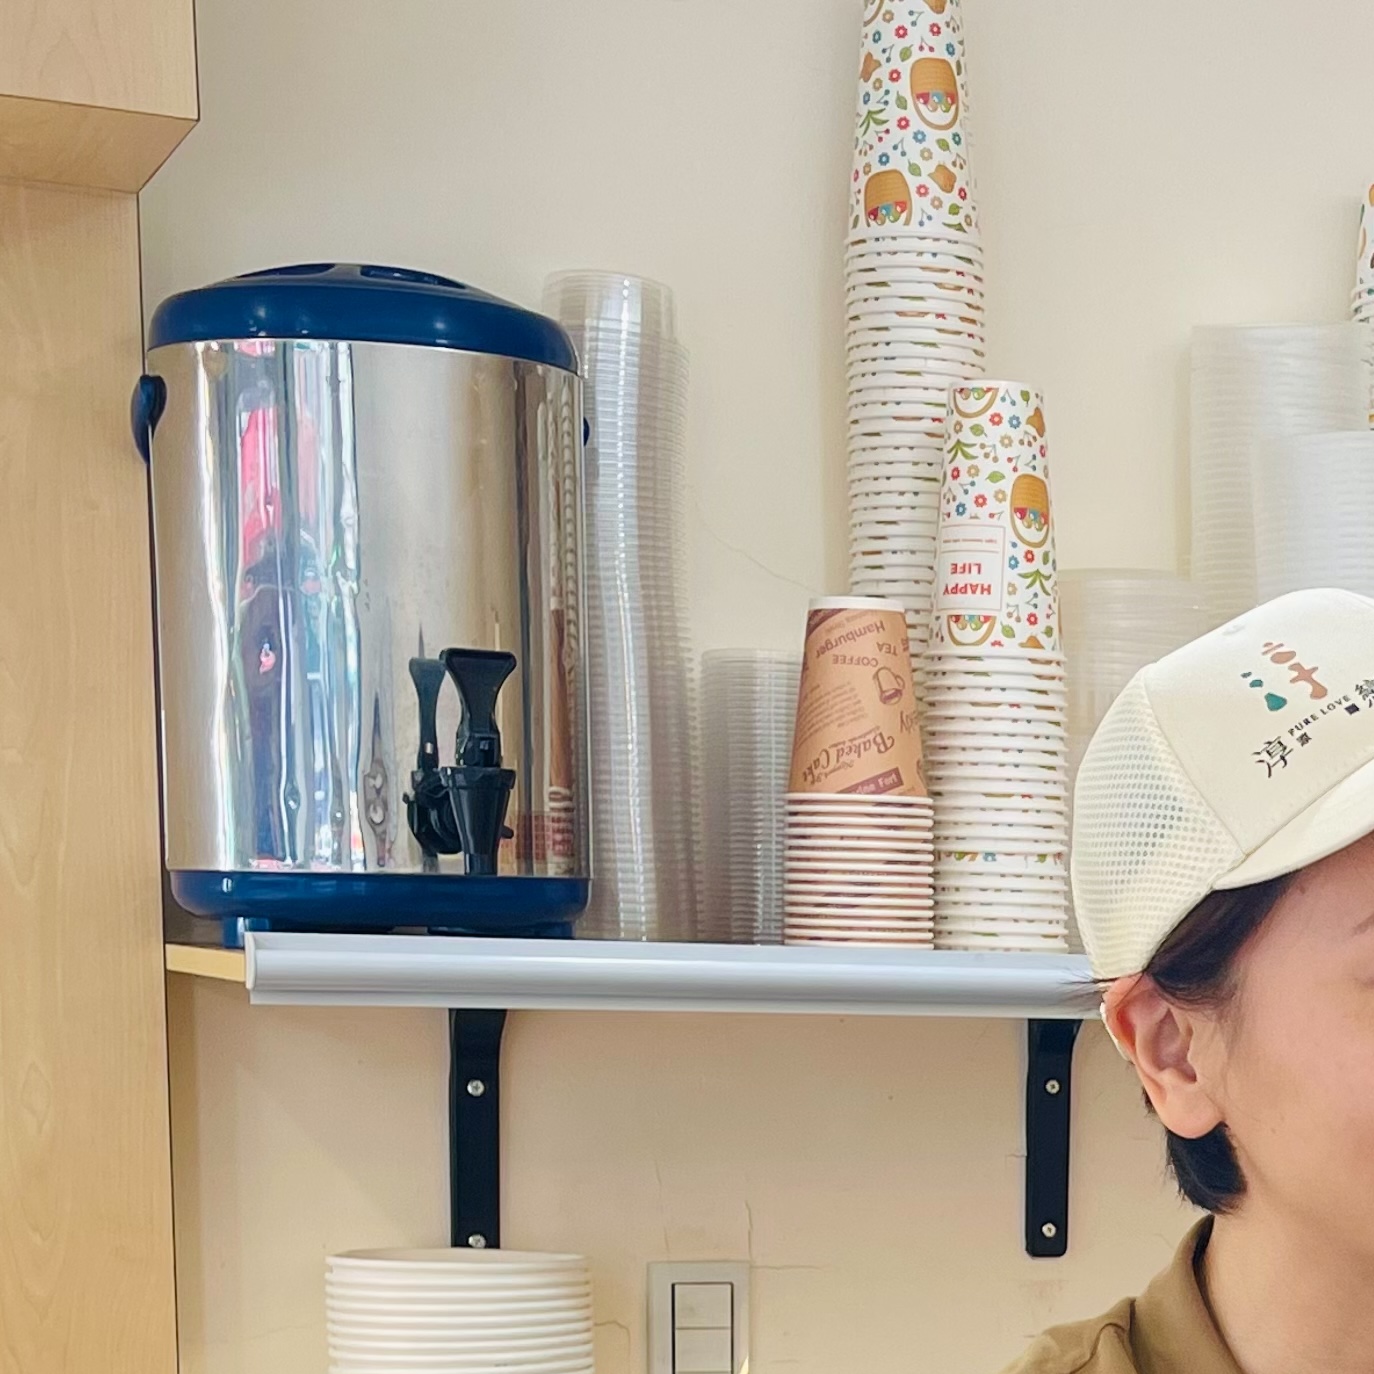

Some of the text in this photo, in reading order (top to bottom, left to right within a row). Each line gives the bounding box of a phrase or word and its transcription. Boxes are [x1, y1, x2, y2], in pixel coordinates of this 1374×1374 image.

[950, 563, 982, 575] LIFE
[943, 583, 992, 596] HAPPY
[815, 619, 886, 659] Hamburger
[876, 641, 899, 657] TEA
[832, 654, 879, 668] COFFEE
[1288, 713, 1319, 737] PURE
[1320, 694, 1351, 716] LOVE
[832, 733, 896, 764] Baked
[1251, 735, 1293, 778] 淳
